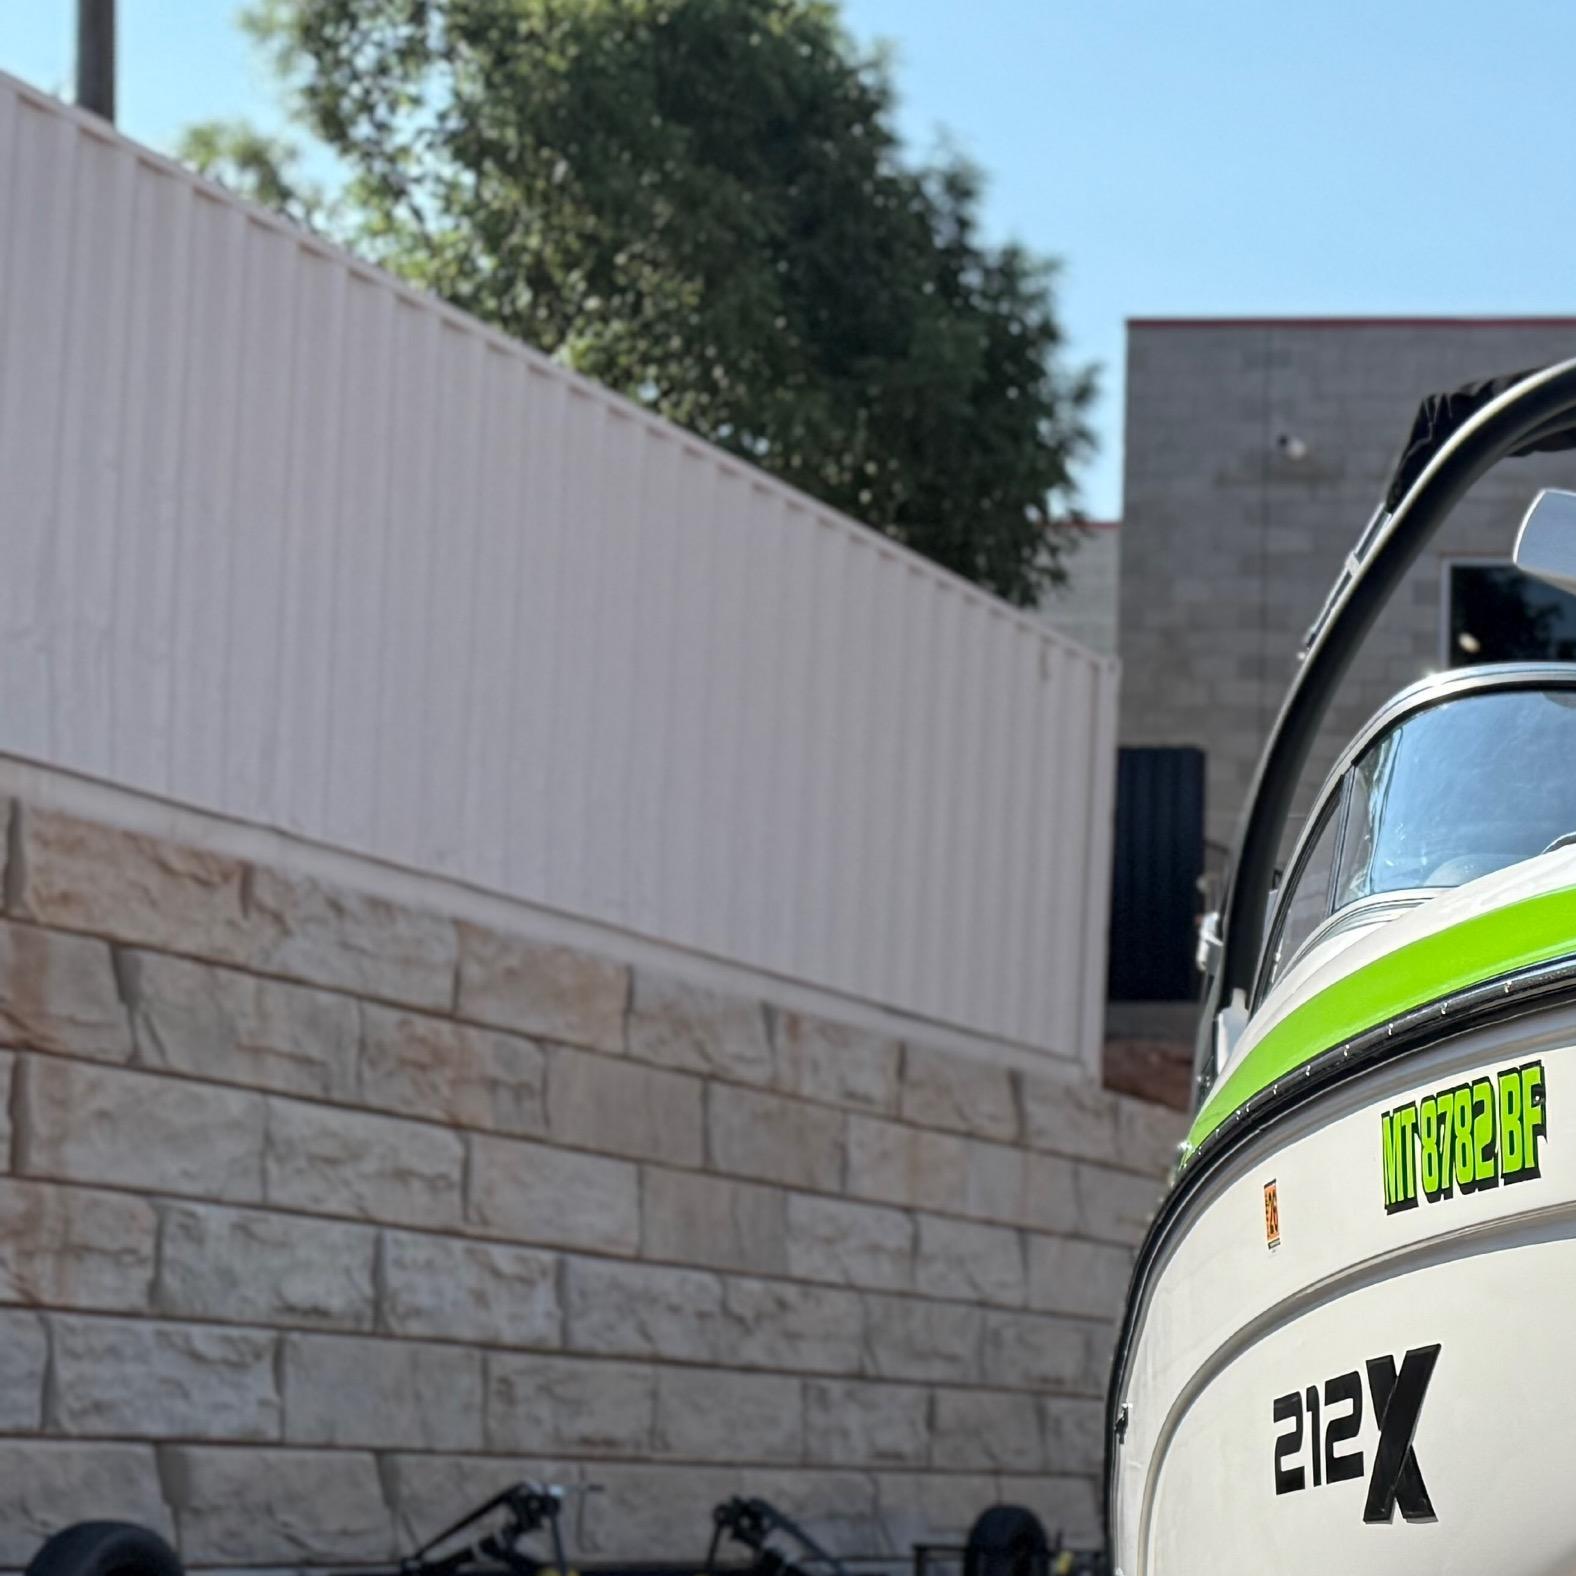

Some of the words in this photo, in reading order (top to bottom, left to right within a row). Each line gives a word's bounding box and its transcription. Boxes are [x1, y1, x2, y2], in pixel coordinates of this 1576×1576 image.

[1381, 1101, 1418, 1214] MT
[1420, 1076, 1499, 1204] 8782
[1497, 1060, 1547, 1186] BF
[1273, 1343, 1442, 1525] 212X
